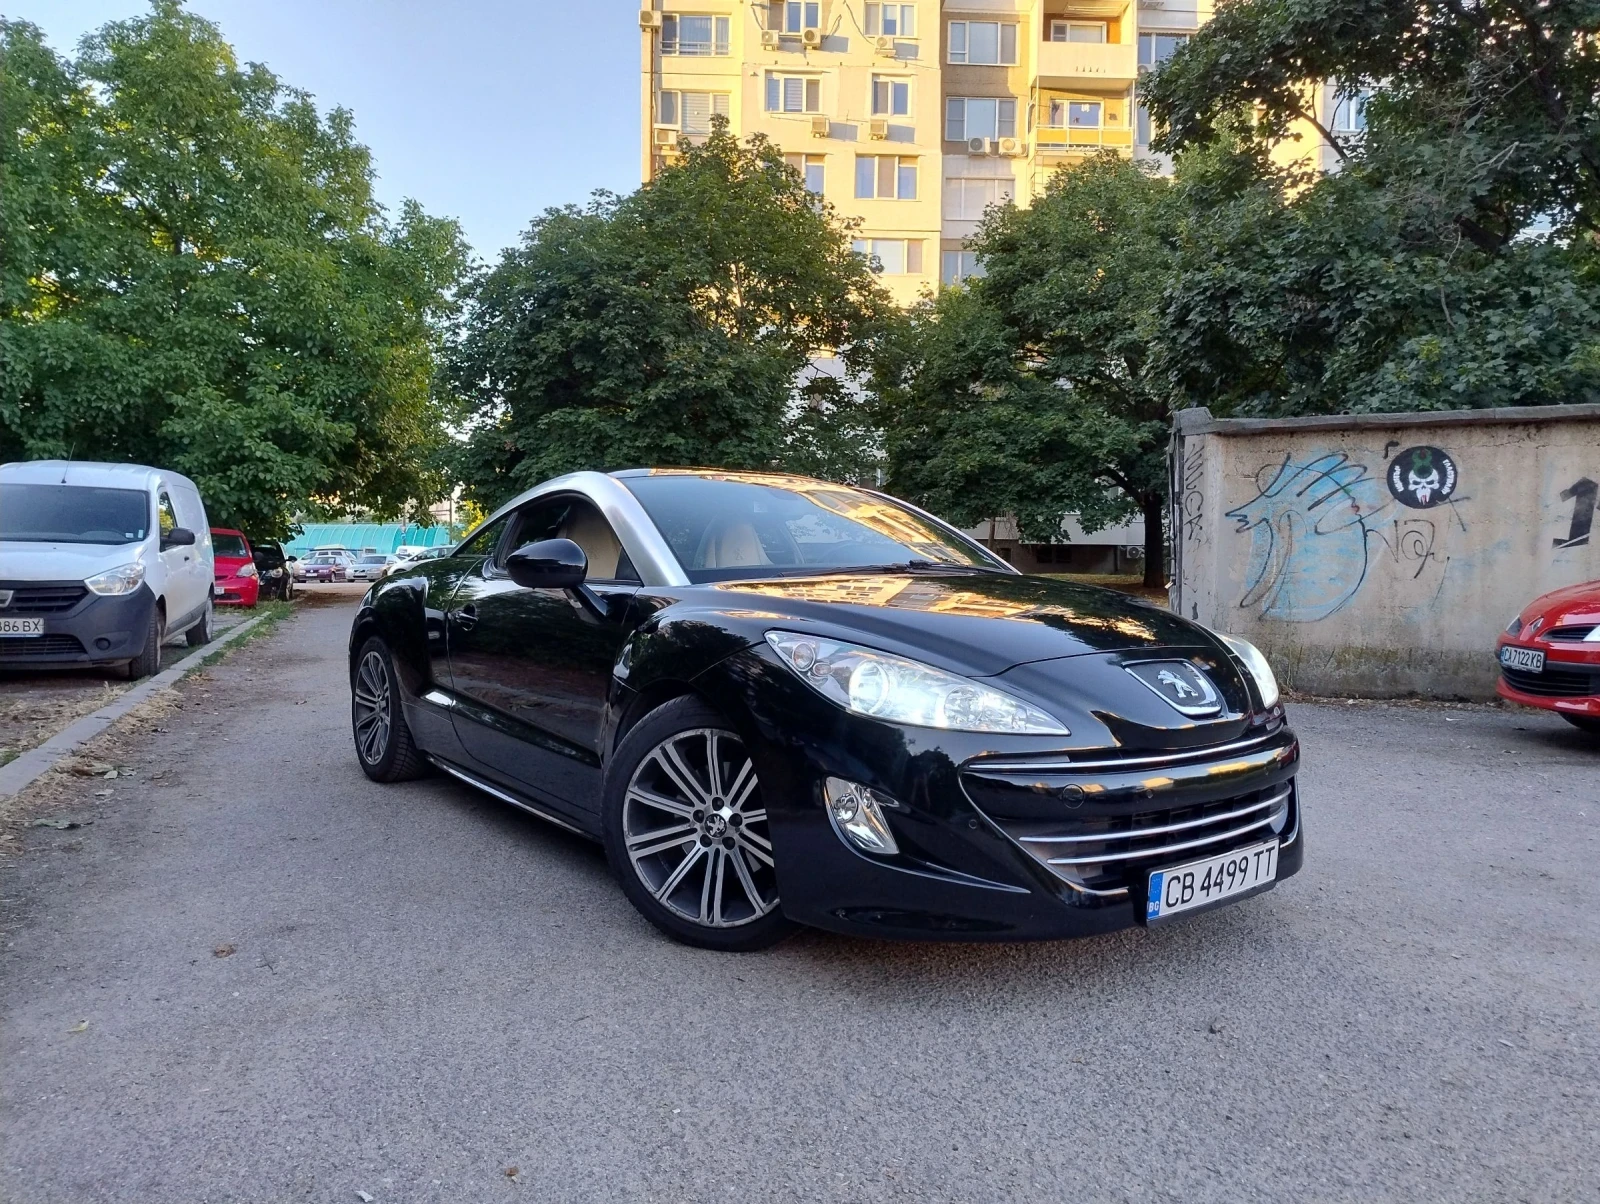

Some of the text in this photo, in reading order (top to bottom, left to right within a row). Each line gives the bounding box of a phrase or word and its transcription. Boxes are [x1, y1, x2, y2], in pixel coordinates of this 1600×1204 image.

[1552, 476, 1600, 549] 1
[22, 620, 41, 632] BX
[1513, 649, 1530, 667] 7122
[1165, 845, 1276, 908] CB 4499 TT
[1148, 901, 1160, 912] BG
